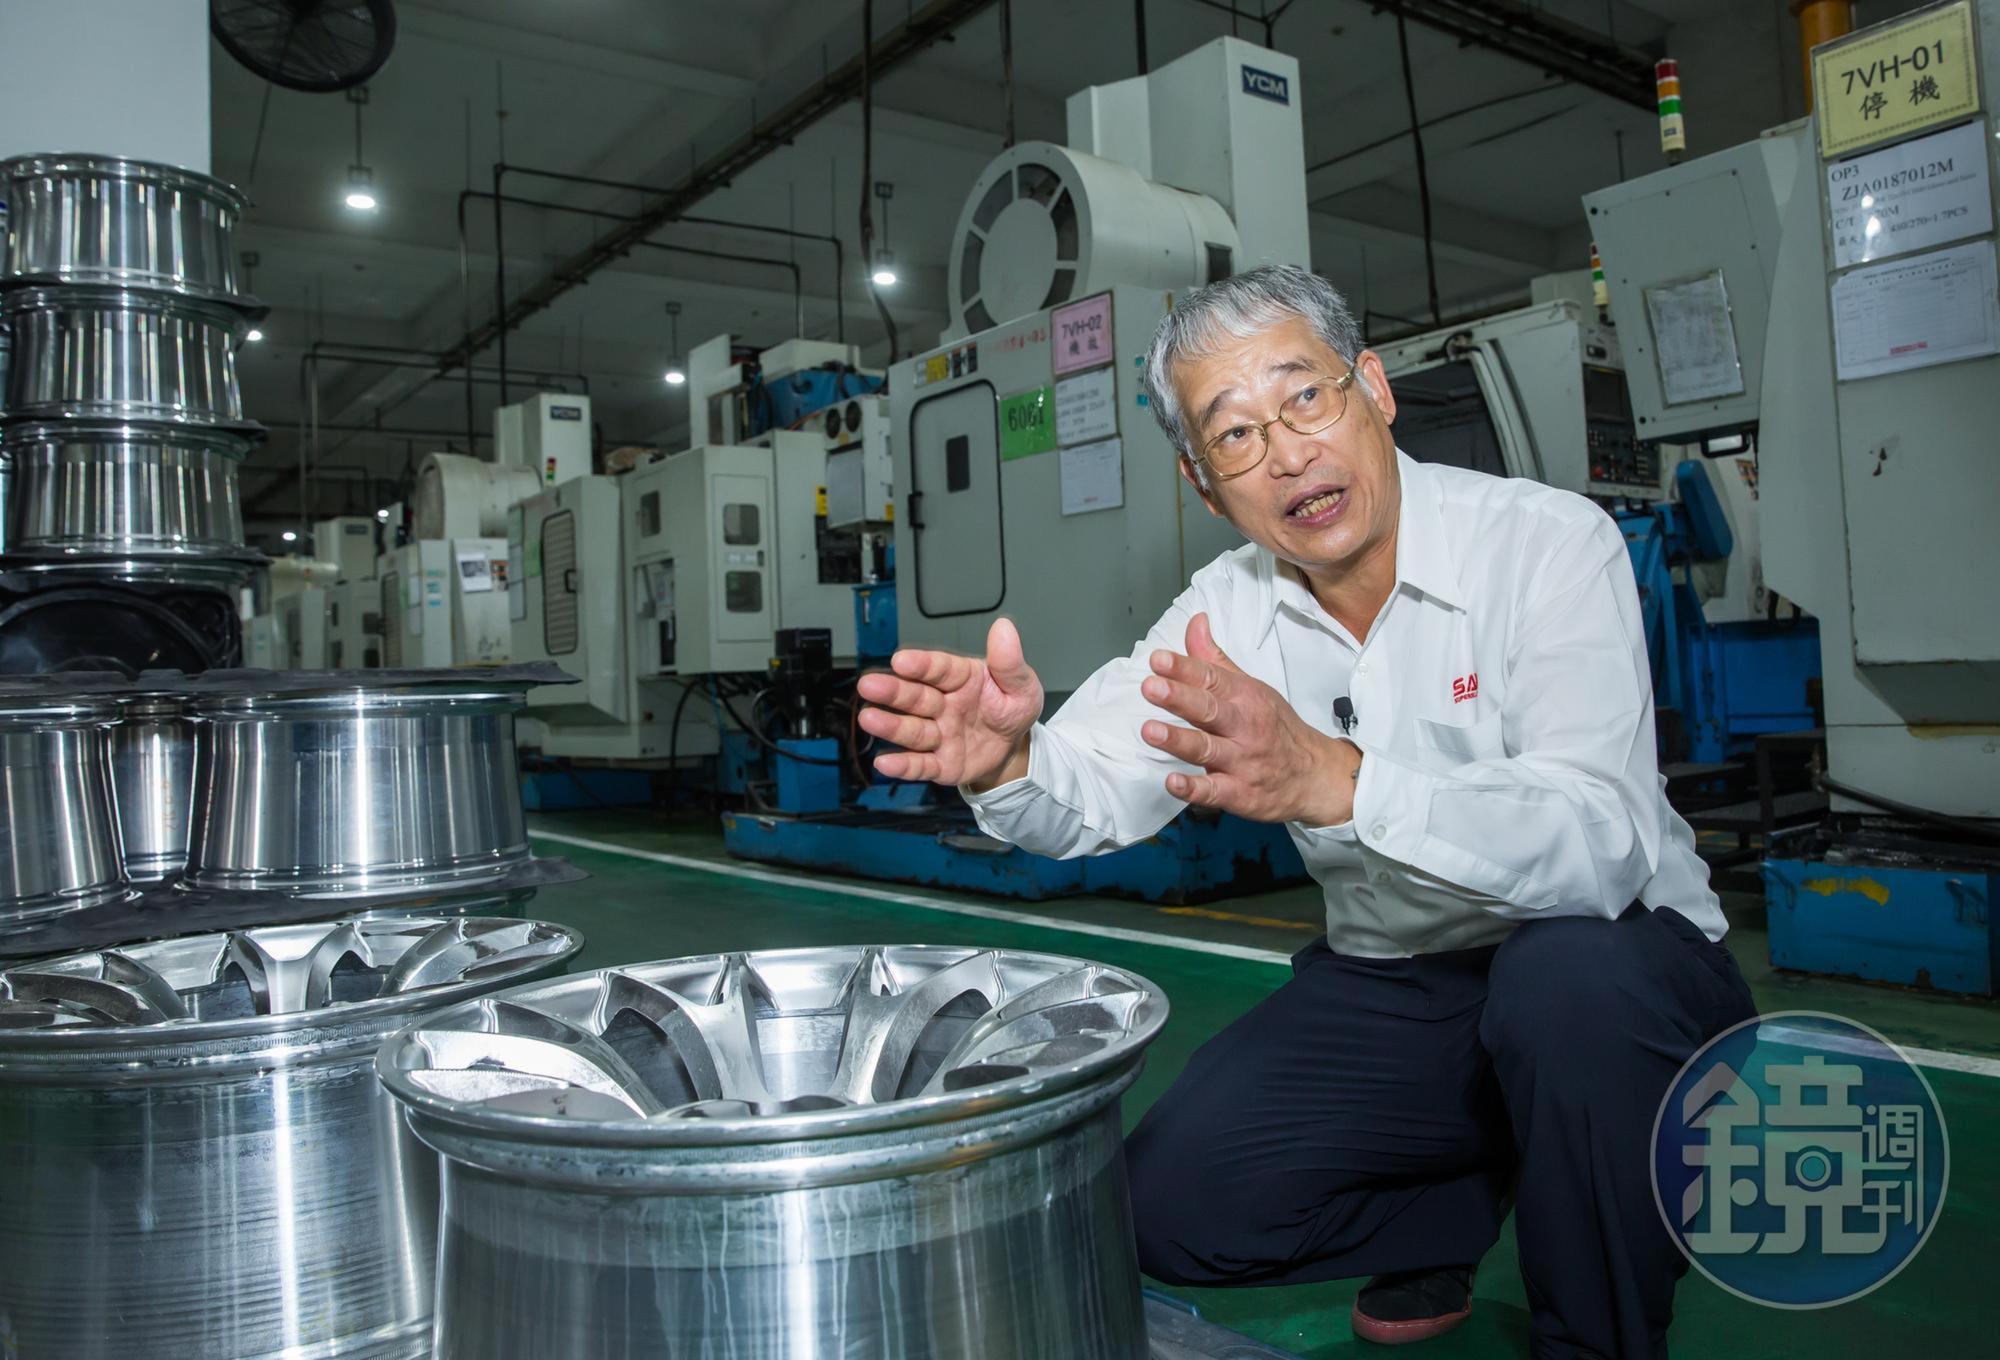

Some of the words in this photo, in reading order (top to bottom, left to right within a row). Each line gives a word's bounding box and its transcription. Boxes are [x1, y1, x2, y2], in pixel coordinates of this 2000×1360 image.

[1841, 39, 1943, 95] 7VH-01
[1244, 70, 1286, 97] YCM
[1859, 75, 1940, 120] 停機
[1831, 164, 1860, 183] OP3
[1061, 314, 1103, 341] 7VH-02
